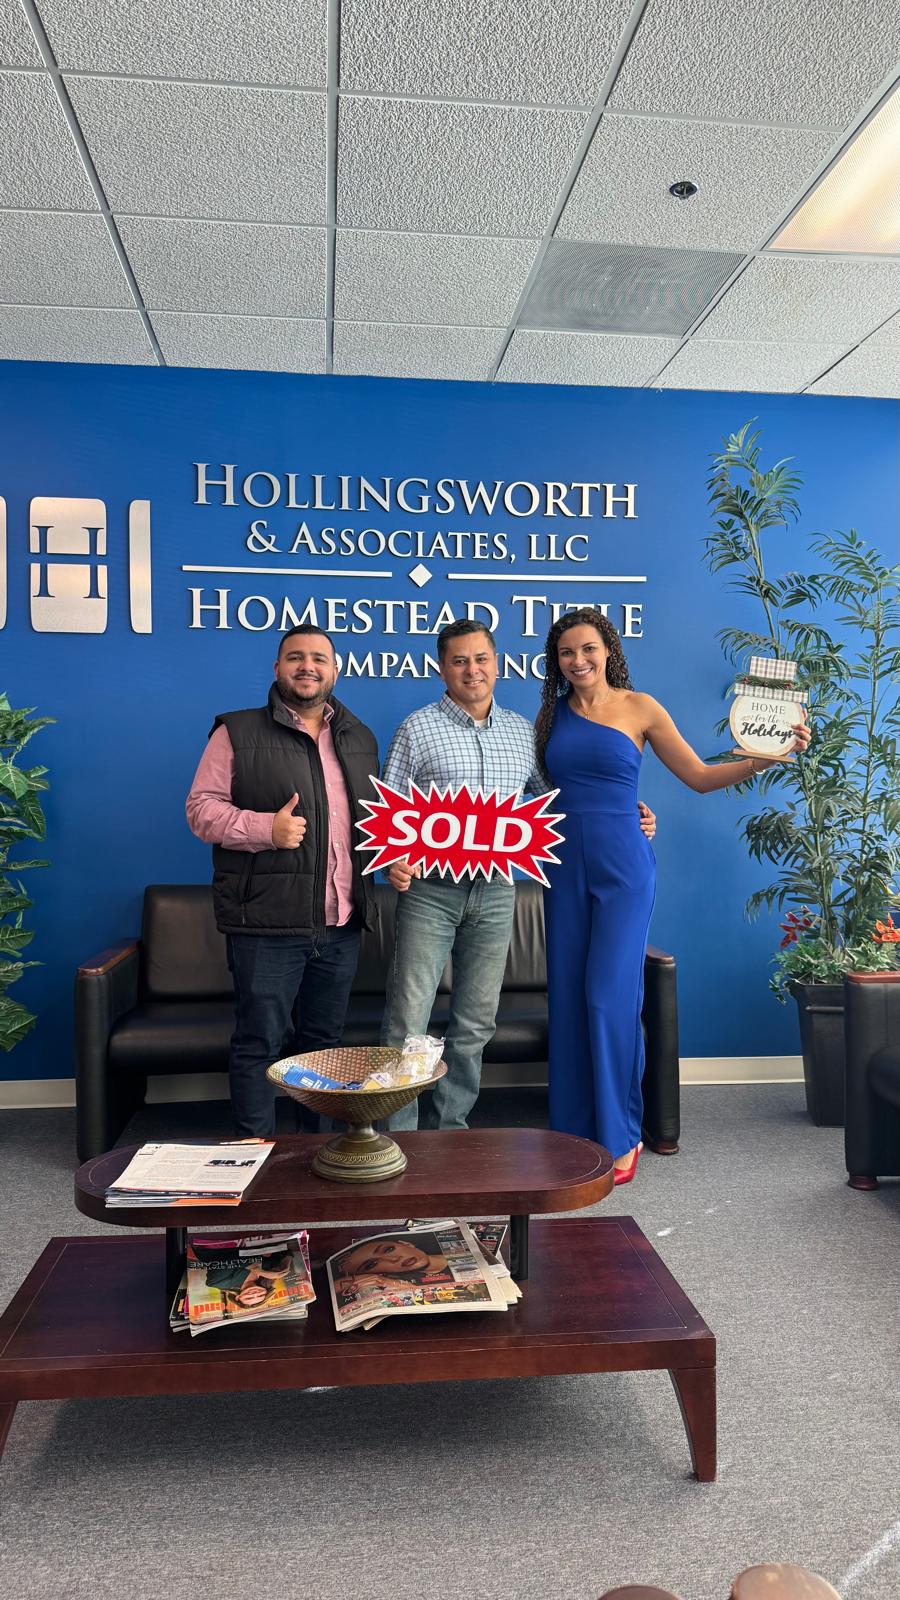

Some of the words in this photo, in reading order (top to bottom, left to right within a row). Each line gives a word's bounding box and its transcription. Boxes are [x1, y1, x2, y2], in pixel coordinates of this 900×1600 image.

[193, 462, 638, 520] HOLLINGSWORTH
[246, 520, 282, 553] &
[288, 521, 516, 563] ASSOCIATES,
[528, 534, 590, 562] LLC
[187, 587, 500, 635] HOMESTEAD
[511, 595, 643, 638] TIE
[751, 702, 787, 714] HOME
[740, 721, 795, 744] Holidays
[387, 809, 533, 853] SOLD
